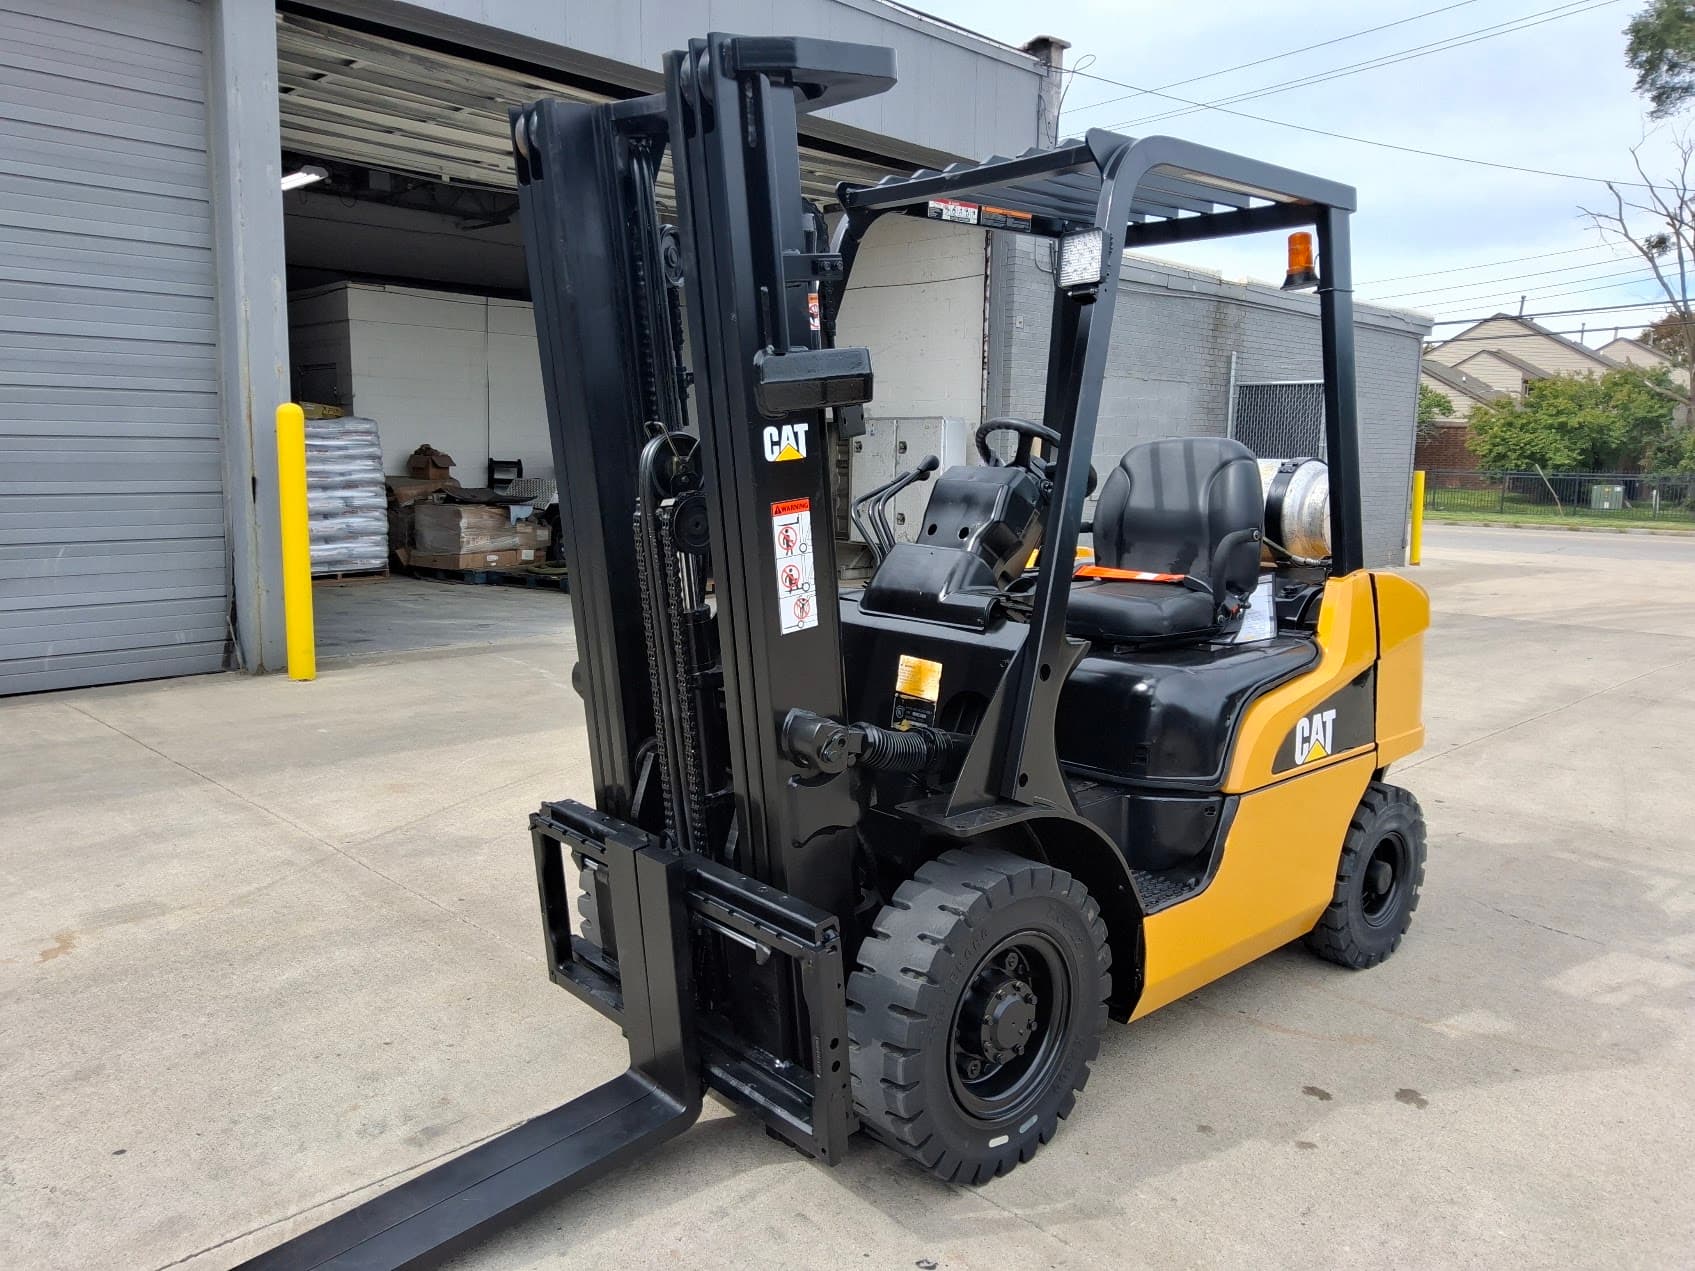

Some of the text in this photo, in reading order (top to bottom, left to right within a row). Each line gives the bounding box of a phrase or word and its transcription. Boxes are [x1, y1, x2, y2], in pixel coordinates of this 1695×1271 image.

[763, 423, 809, 462] CAT
[781, 503, 808, 512] WARNING
[1295, 709, 1337, 765] CAT
